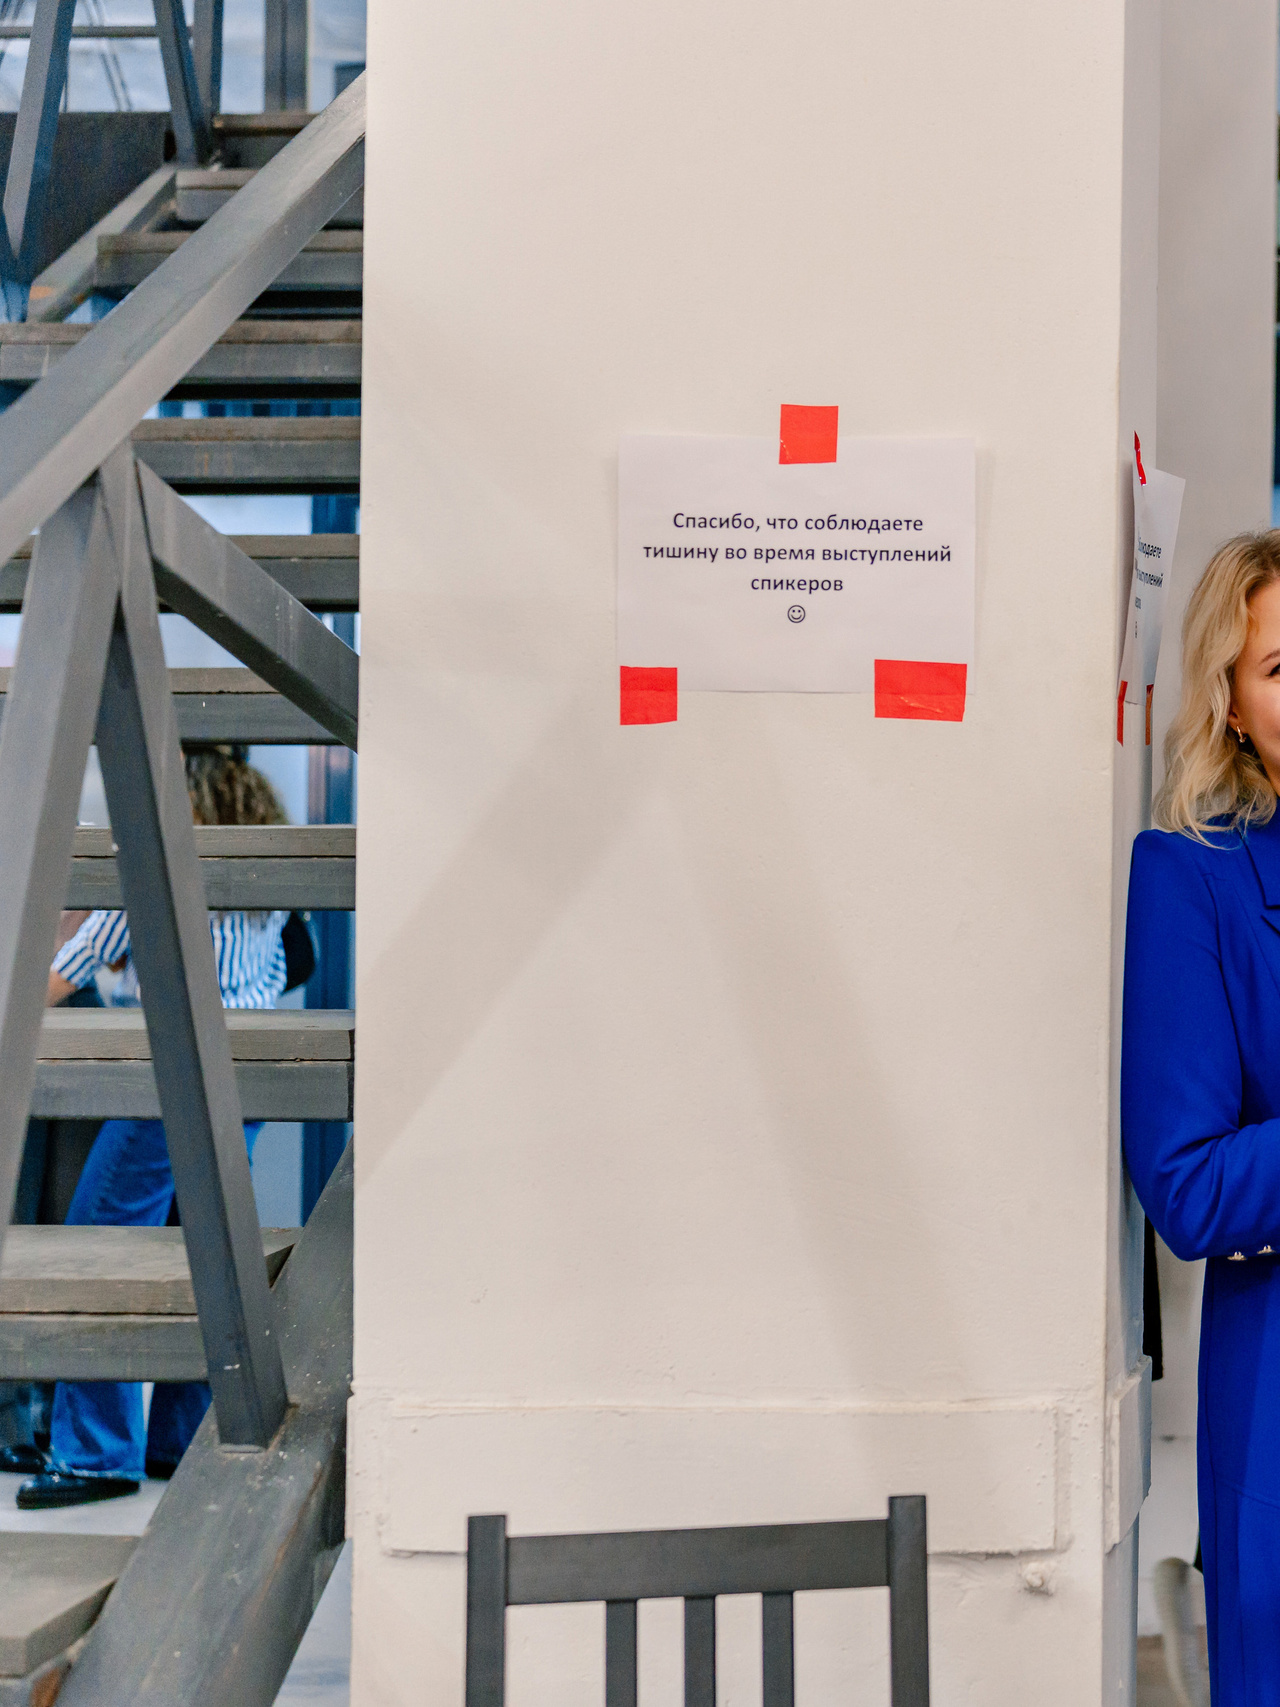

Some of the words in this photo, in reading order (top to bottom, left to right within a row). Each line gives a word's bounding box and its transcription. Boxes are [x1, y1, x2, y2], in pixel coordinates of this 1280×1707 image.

[674, 513, 759, 532] Спасибо,
[767, 518, 798, 529] что
[805, 514, 923, 534] соблюдаете
[643, 547, 718, 563] тишину
[726, 548, 746, 559] во
[754, 548, 814, 563] время
[823, 546, 950, 565] выступлений
[751, 579, 843, 594] спикеров
